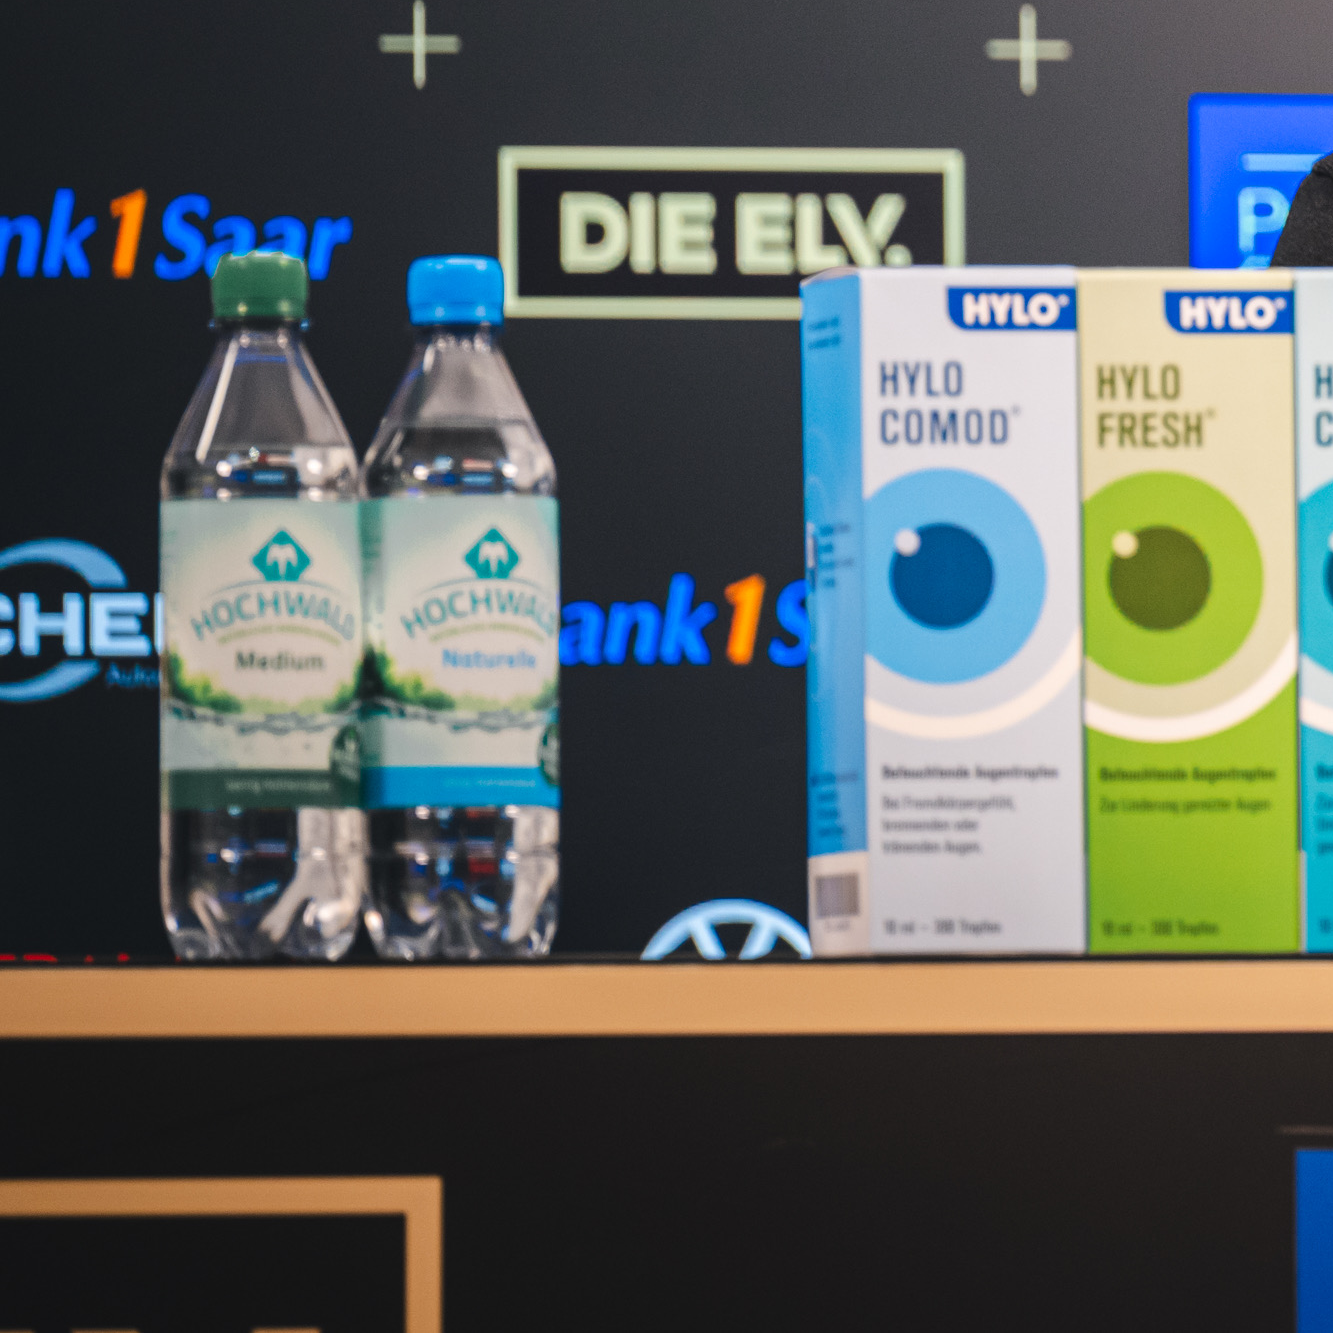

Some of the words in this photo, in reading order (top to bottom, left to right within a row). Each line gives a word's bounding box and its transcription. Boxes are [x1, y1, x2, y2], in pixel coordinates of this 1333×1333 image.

[559, 191, 717, 275] DIE
[880, 361, 963, 397] HYLO
[1096, 364, 1180, 400] HYLO
[190, 590, 356, 641] HOCHWALD
[559, 572, 718, 666] ank
[235, 651, 325, 671] Medium
